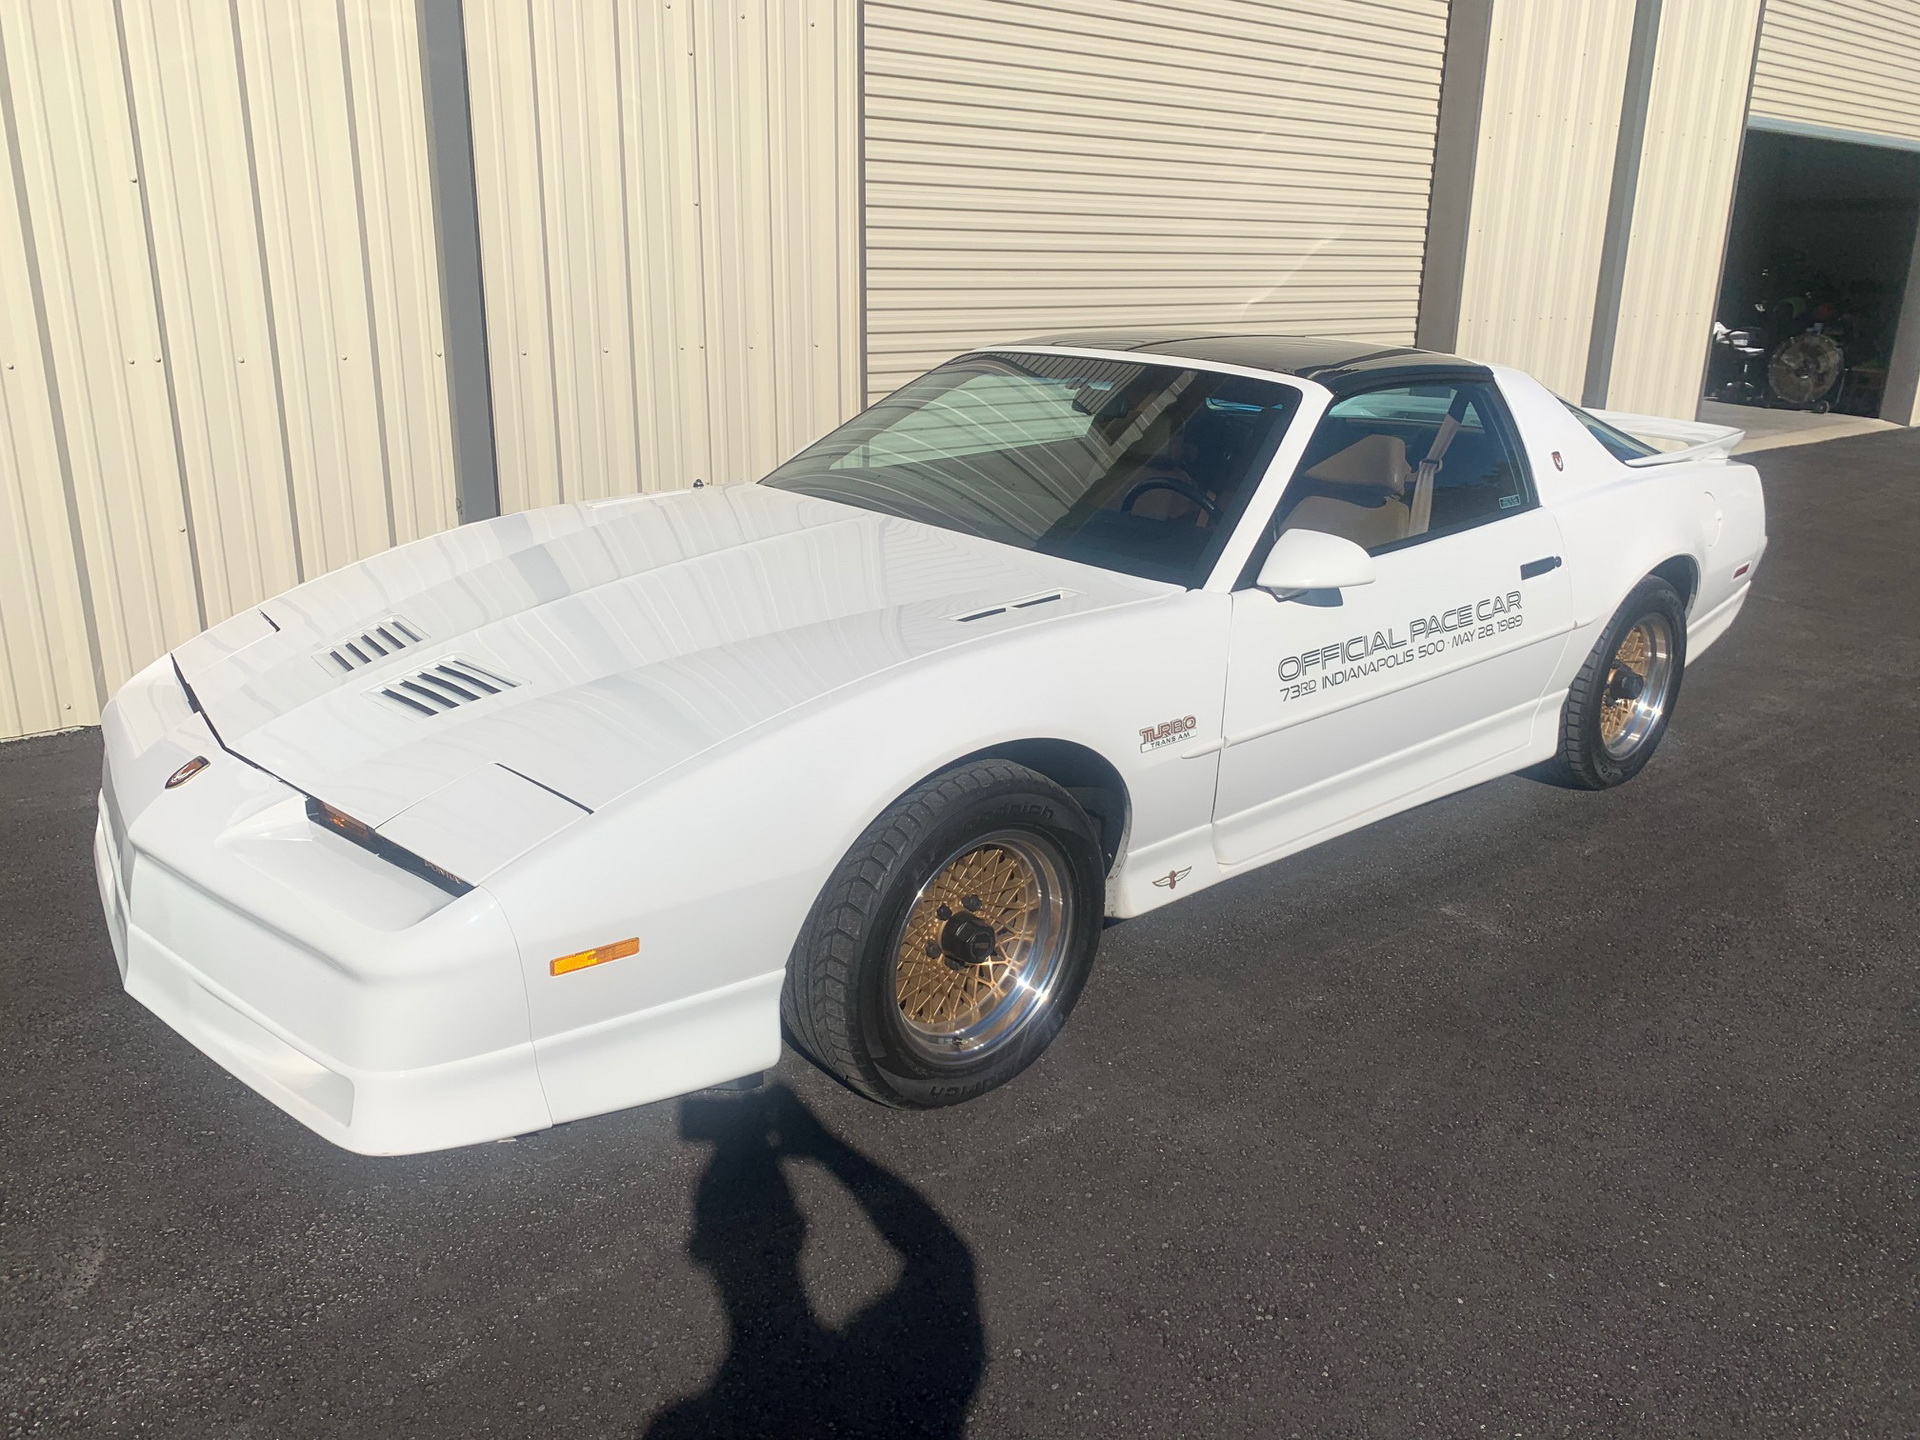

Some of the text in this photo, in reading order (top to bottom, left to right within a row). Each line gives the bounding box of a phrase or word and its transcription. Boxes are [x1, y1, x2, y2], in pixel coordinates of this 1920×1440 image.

[1277, 590, 1523, 682] OFFICIAL PACE CAR
[1279, 679, 1317, 702] 73RD
[1321, 649, 1415, 690] INDIANAPOLIS
[1418, 639, 1446, 659] 500
[1451, 630, 1477, 648] MAY
[1497, 614, 1523, 632] 1989
[1139, 715, 1197, 744] TURBO
[1150, 731, 1191, 749] TRANS AM
